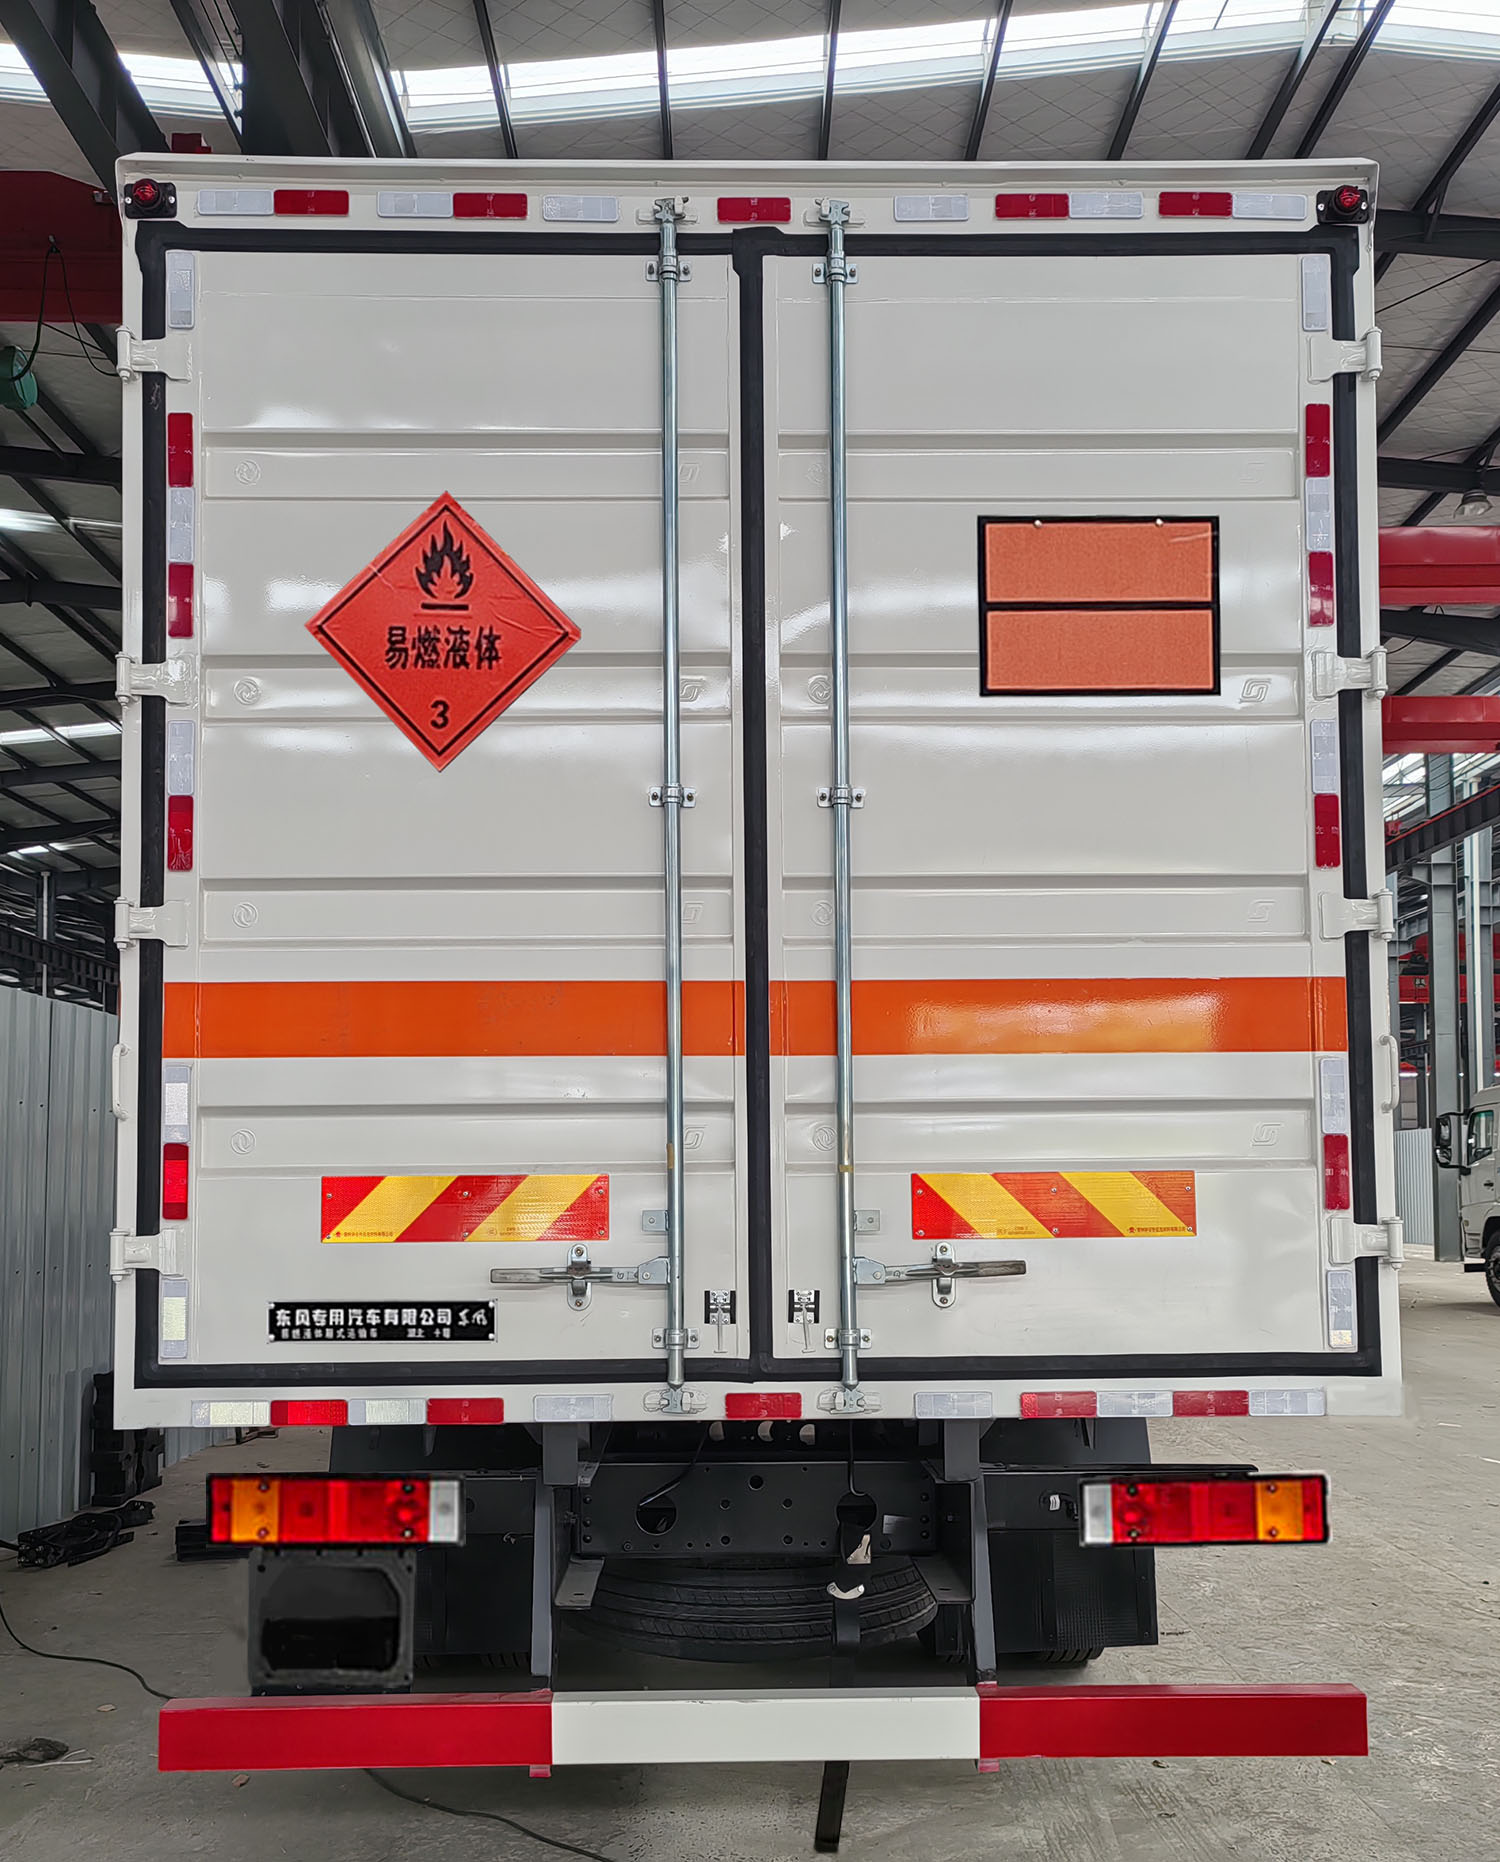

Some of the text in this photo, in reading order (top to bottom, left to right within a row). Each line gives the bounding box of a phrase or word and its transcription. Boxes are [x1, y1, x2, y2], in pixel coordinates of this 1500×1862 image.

[384, 624, 503, 671] 易燃液体
[430, 700, 450, 729] 3
[275, 1308, 452, 1327] 东风专用汽车有限公司
